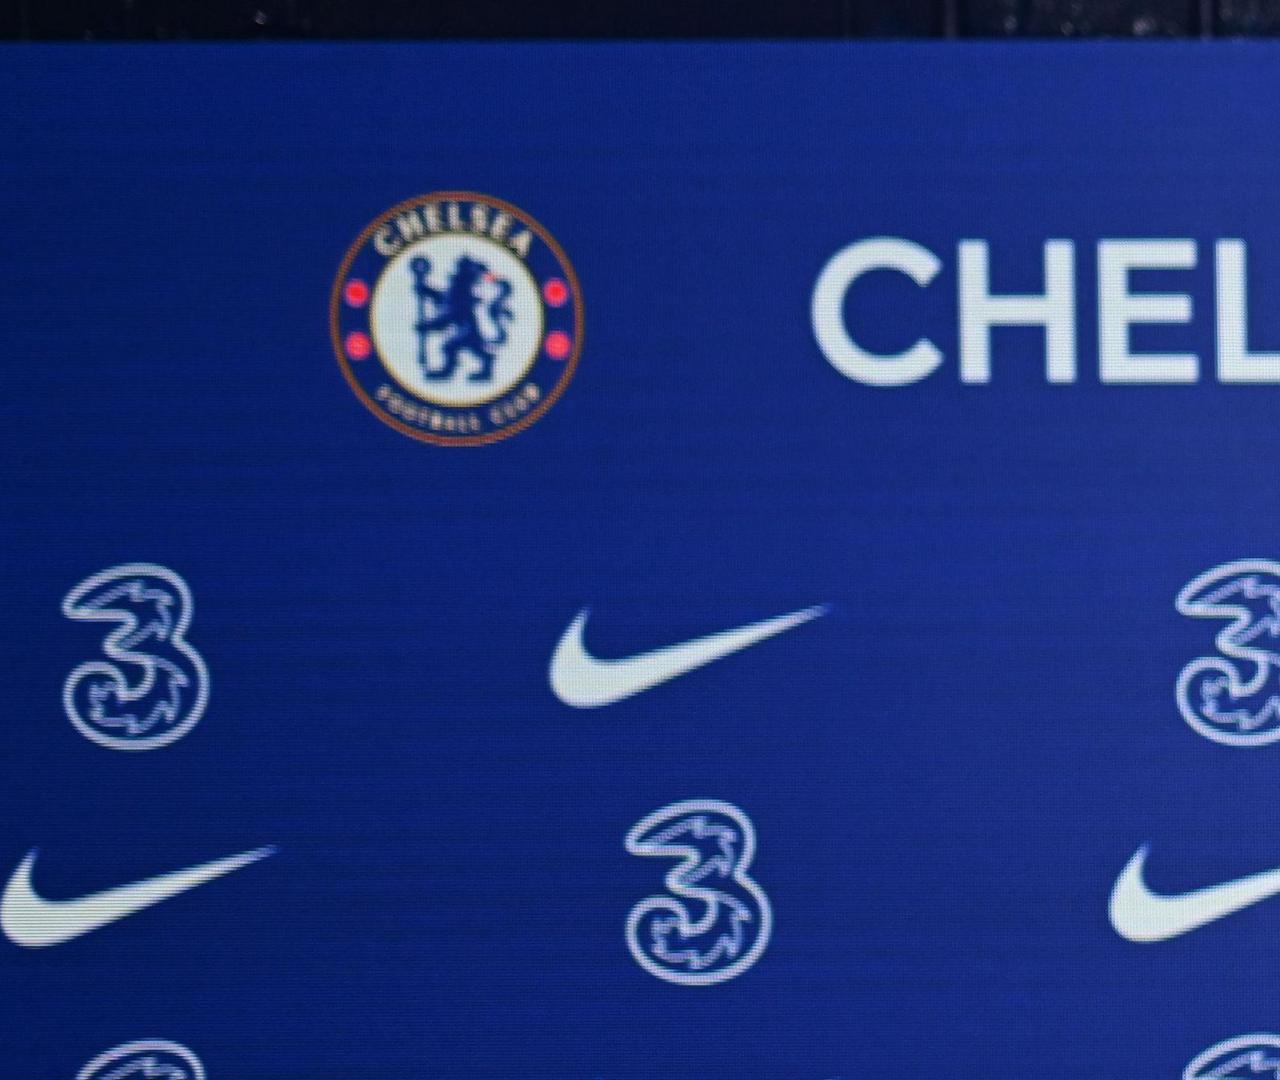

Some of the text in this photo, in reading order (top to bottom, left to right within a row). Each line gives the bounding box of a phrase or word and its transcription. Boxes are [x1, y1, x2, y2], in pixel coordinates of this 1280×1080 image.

[374, 201, 533, 257] CHELSEA
[62, 562, 209, 751] 3
[625, 800, 771, 985] 3
